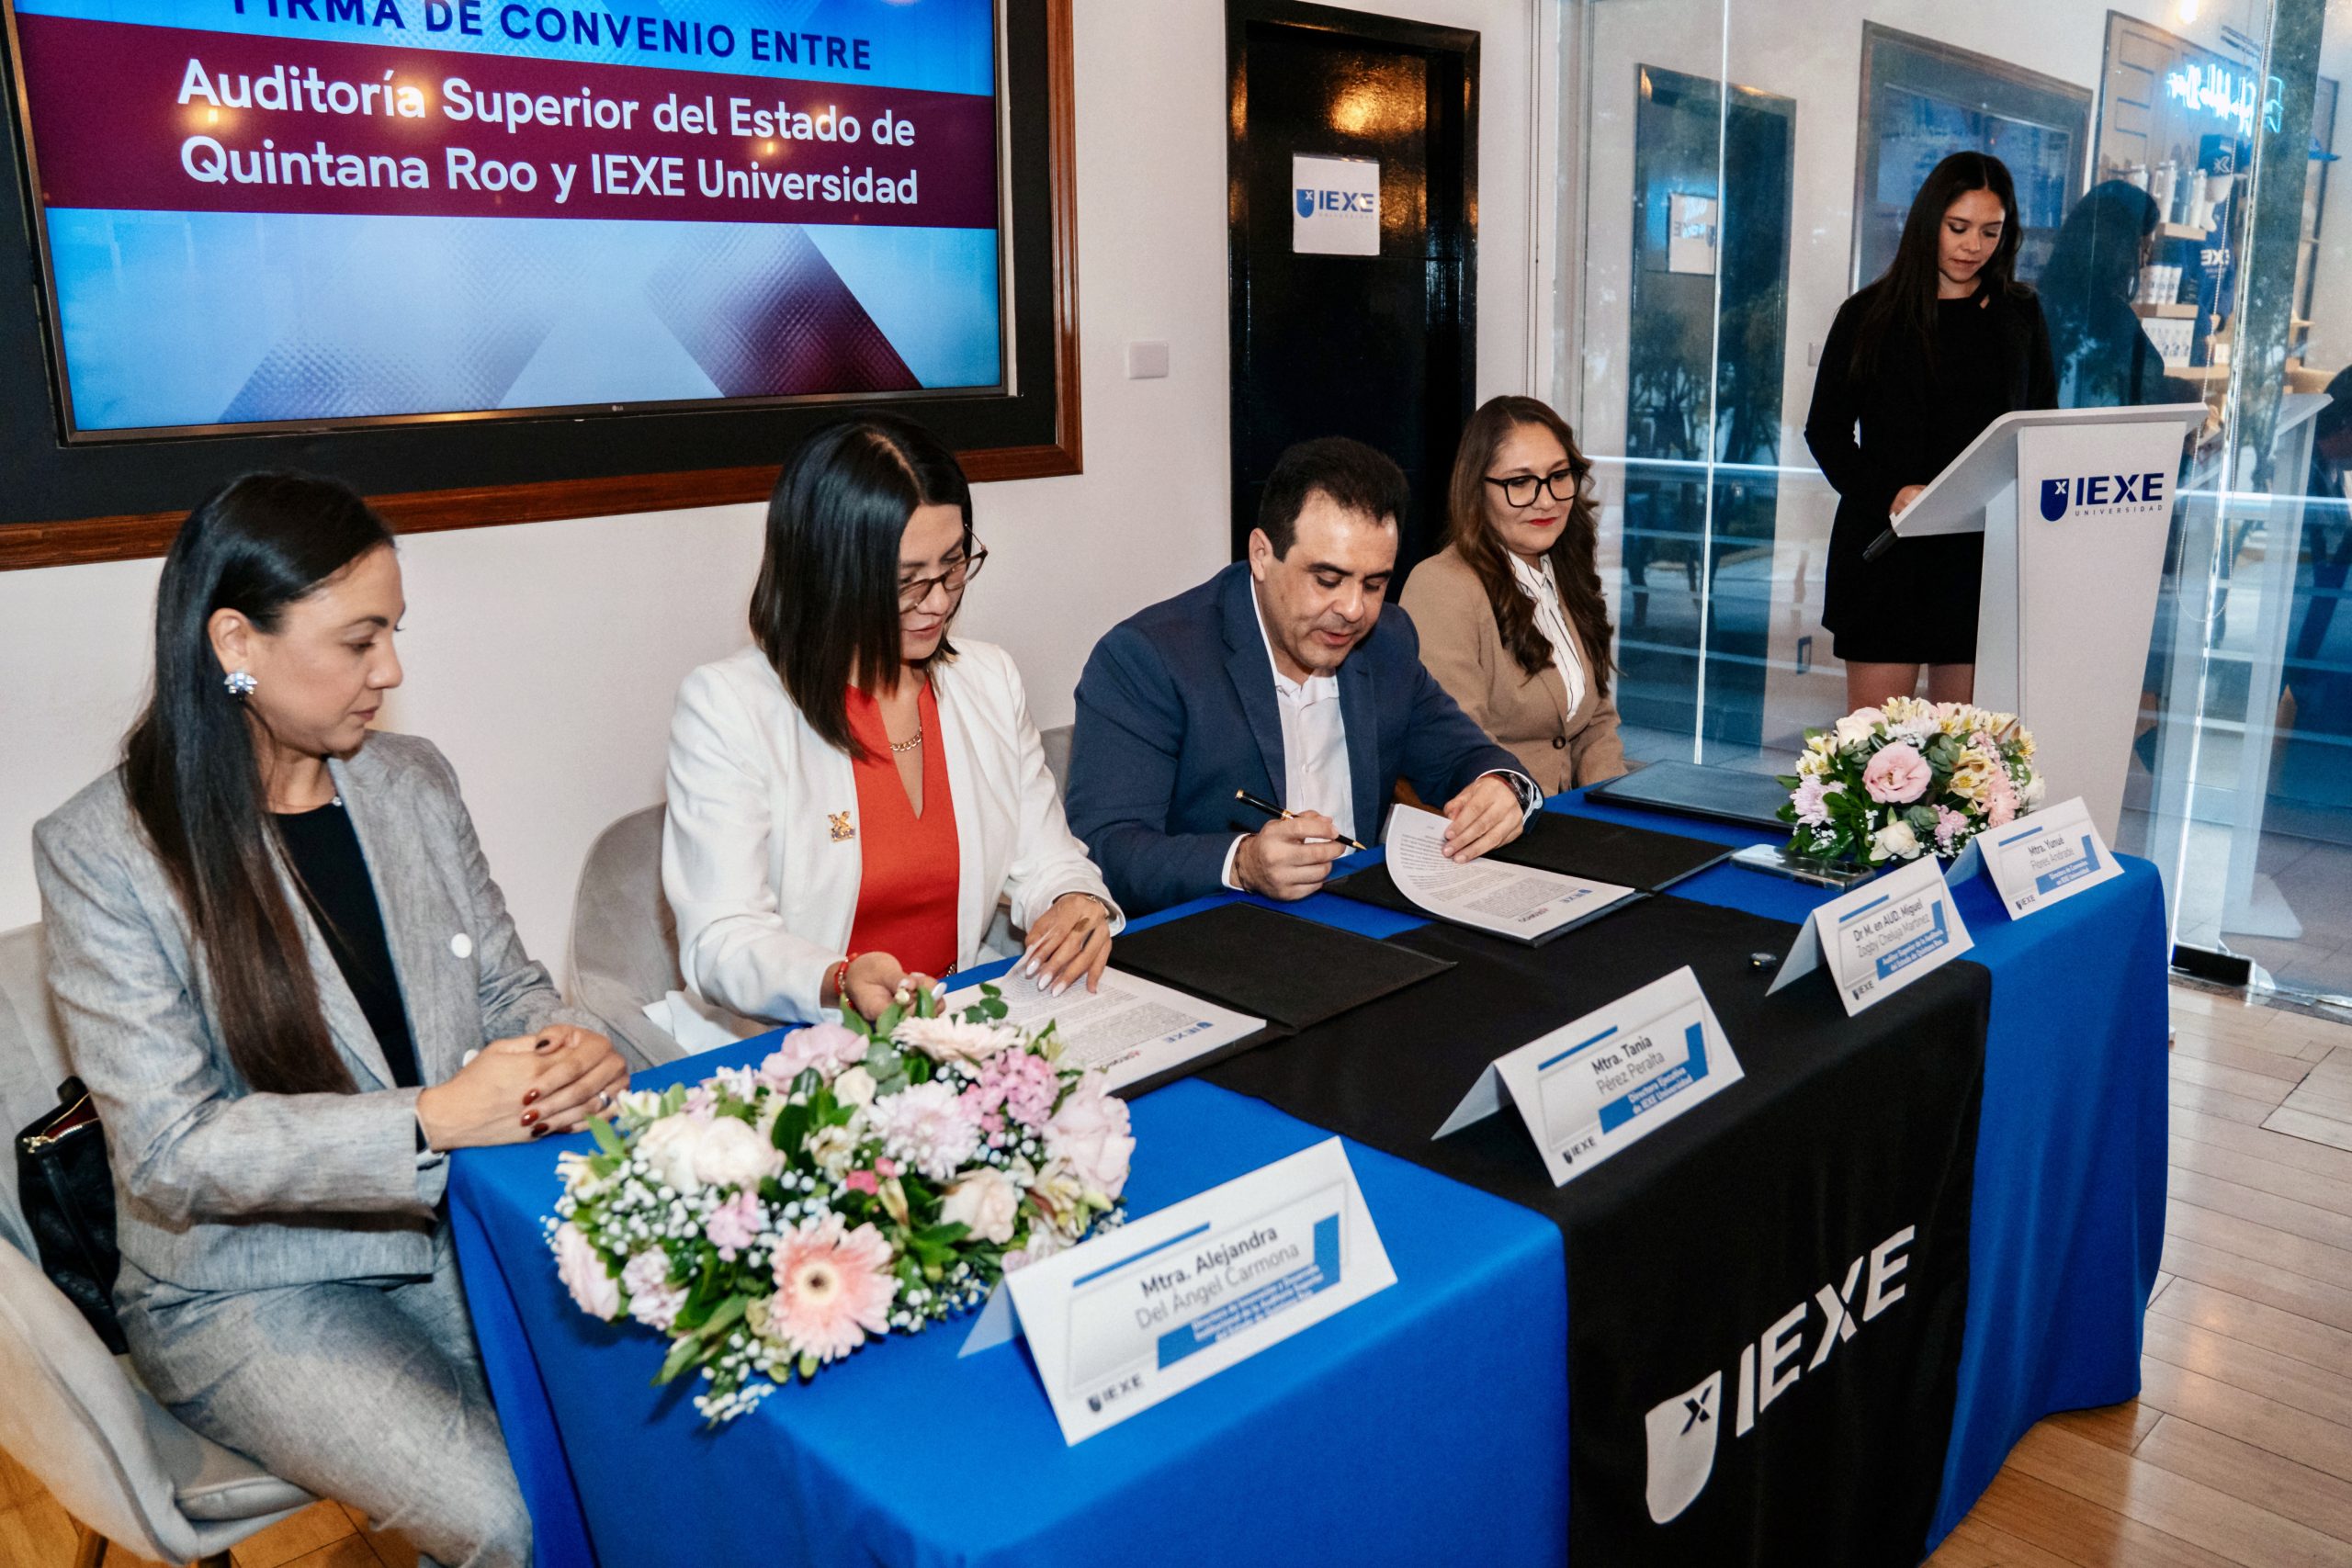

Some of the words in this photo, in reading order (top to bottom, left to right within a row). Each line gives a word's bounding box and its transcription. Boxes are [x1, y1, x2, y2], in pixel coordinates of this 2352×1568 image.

[424, 0, 483, 36] DE
[500, 4, 735, 58] CONVENIO
[750, 28, 872, 71] ENTRE
[177, 58, 426, 118] Auditoría
[442, 77, 639, 134] Superior
[651, 93, 718, 135] del
[729, 96, 862, 143] Estado
[871, 108, 917, 147] de
[181, 135, 430, 189] Quintana
[446, 147, 537, 193] Roo
[550, 164, 577, 204] y
[591, 153, 686, 197] IEXE
[697, 158, 919, 205] Universidad
[1318, 189, 1374, 213] IEXE
[2075, 472, 2165, 506] IEXE
[2075, 504, 2163, 516] UNIVERSIDAD
[1873, 920, 1883, 931] en
[1899, 898, 1924, 919] Miguel
[1591, 1052, 1623, 1075] Mtra.
[1621, 1035, 1653, 1058] Tania
[1596, 1069, 1629, 1096] Pérez
[1627, 1049, 1665, 1078] Peralta
[1570, 1136, 1597, 1157] IEXE
[1140, 1267, 1192, 1299] Mtra.
[1194, 1225, 1279, 1274] Alejandra
[1135, 1299, 1169, 1330] Del
[1171, 1275, 1226, 1313] Ángel
[1225, 1242, 1300, 1285] Carmona
[1736, 1224, 1916, 1438] IEXE
[1102, 1373, 1144, 1403] IEXE
